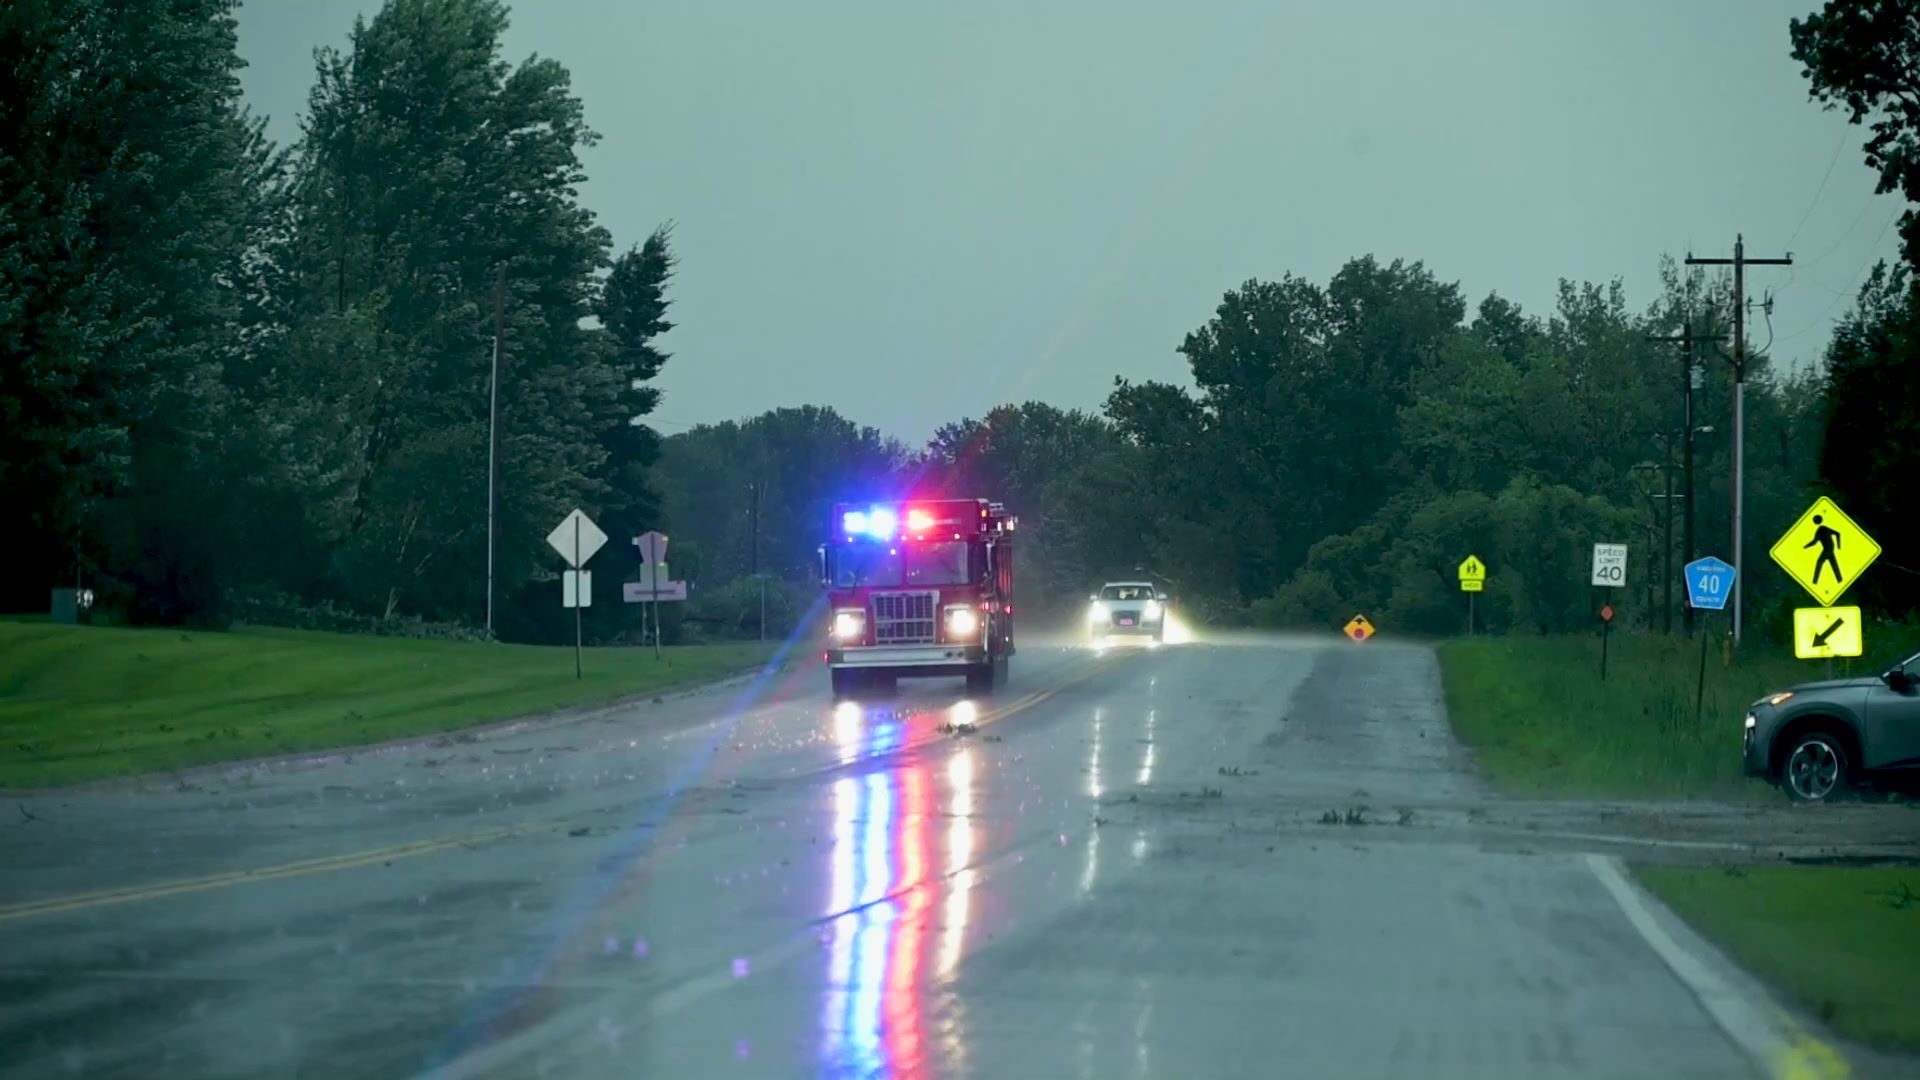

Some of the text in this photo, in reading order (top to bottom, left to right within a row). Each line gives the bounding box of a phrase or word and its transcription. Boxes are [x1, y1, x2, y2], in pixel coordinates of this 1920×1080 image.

[1597, 548, 1624, 557] SPEED
[1596, 566, 1622, 581] 40
[1698, 574, 1720, 594] 40
